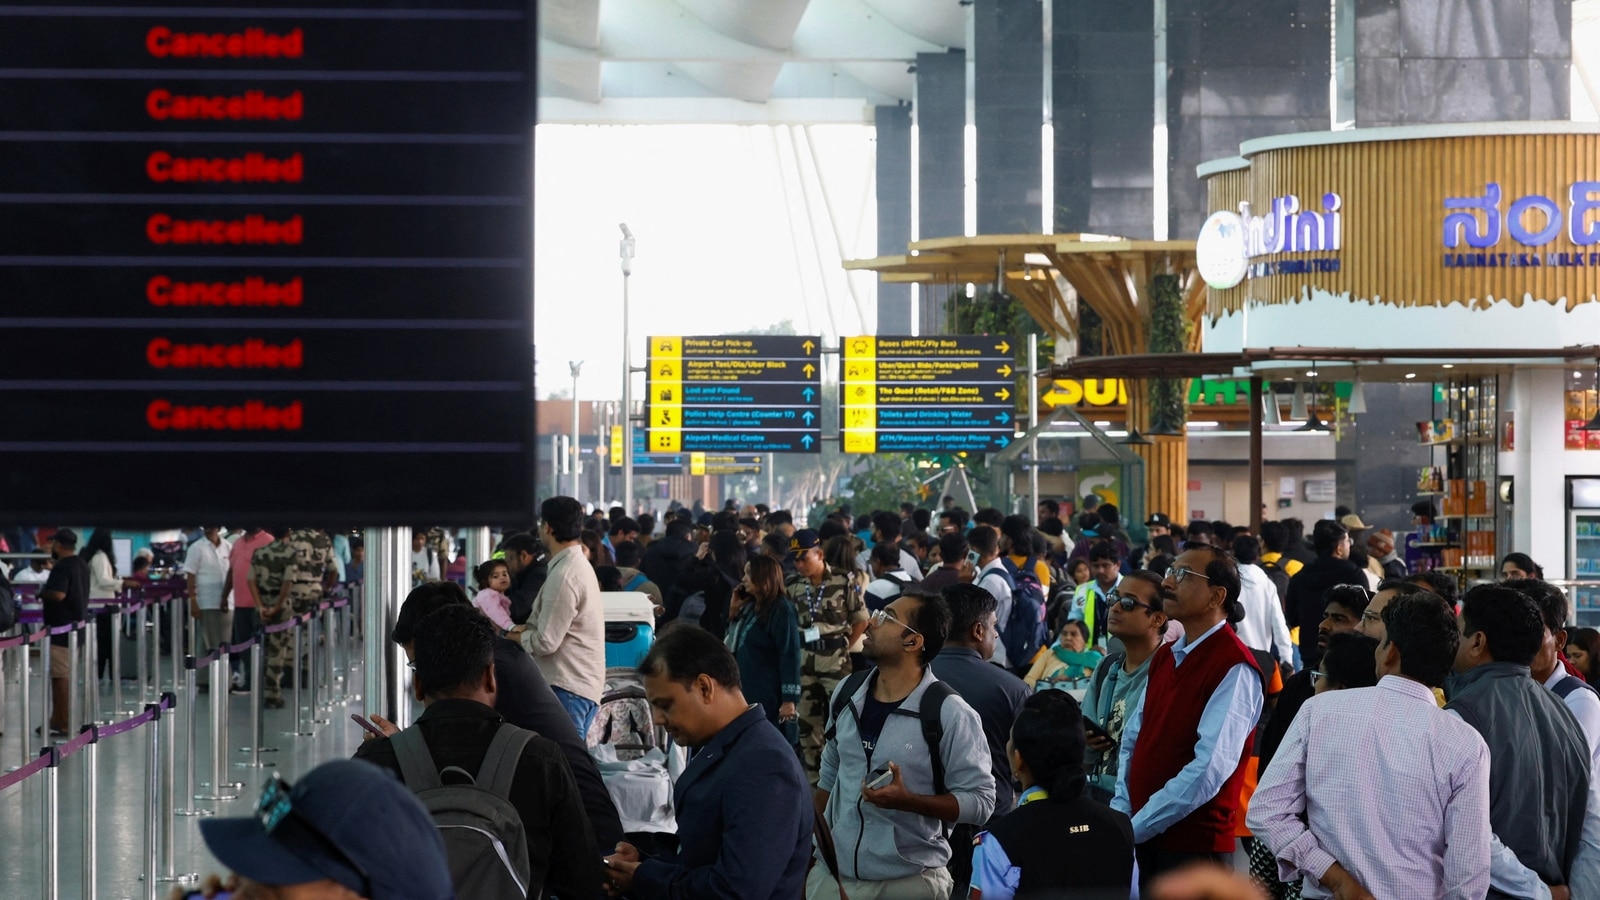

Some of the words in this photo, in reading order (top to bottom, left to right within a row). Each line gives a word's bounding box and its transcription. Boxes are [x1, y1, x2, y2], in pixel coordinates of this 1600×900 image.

[146, 27, 303, 57] Cancelled
[146, 89, 303, 119] Cancelled
[146, 152, 303, 181] Cancelled
[147, 214, 303, 243] Cancelled
[1444, 253, 1541, 267] KARNATAKA
[1546, 253, 1585, 267] MILK
[147, 276, 303, 305] Cancelled
[685, 339, 710, 347] Private
[711, 339, 724, 347] Car
[725, 339, 753, 348] Pick-up
[147, 338, 302, 367] Cancelled
[687, 360, 713, 369] Airport
[766, 360, 787, 368] Black
[957, 387, 979, 395] Zone)
[147, 400, 302, 429] Cancelled
[684, 410, 707, 418] Police
[708, 410, 725, 419] Help
[726, 410, 750, 418] Centre
[751, 410, 783, 419] (Counter
[919, 411, 949, 419] Drinking
[685, 434, 711, 443] Airport
[712, 434, 740, 442] Medical
[741, 434, 765, 442] Centre
[935, 434, 967, 443] Courtesy
[968, 434, 991, 442] Phone
[1069, 824, 1090, 834] S&IB
